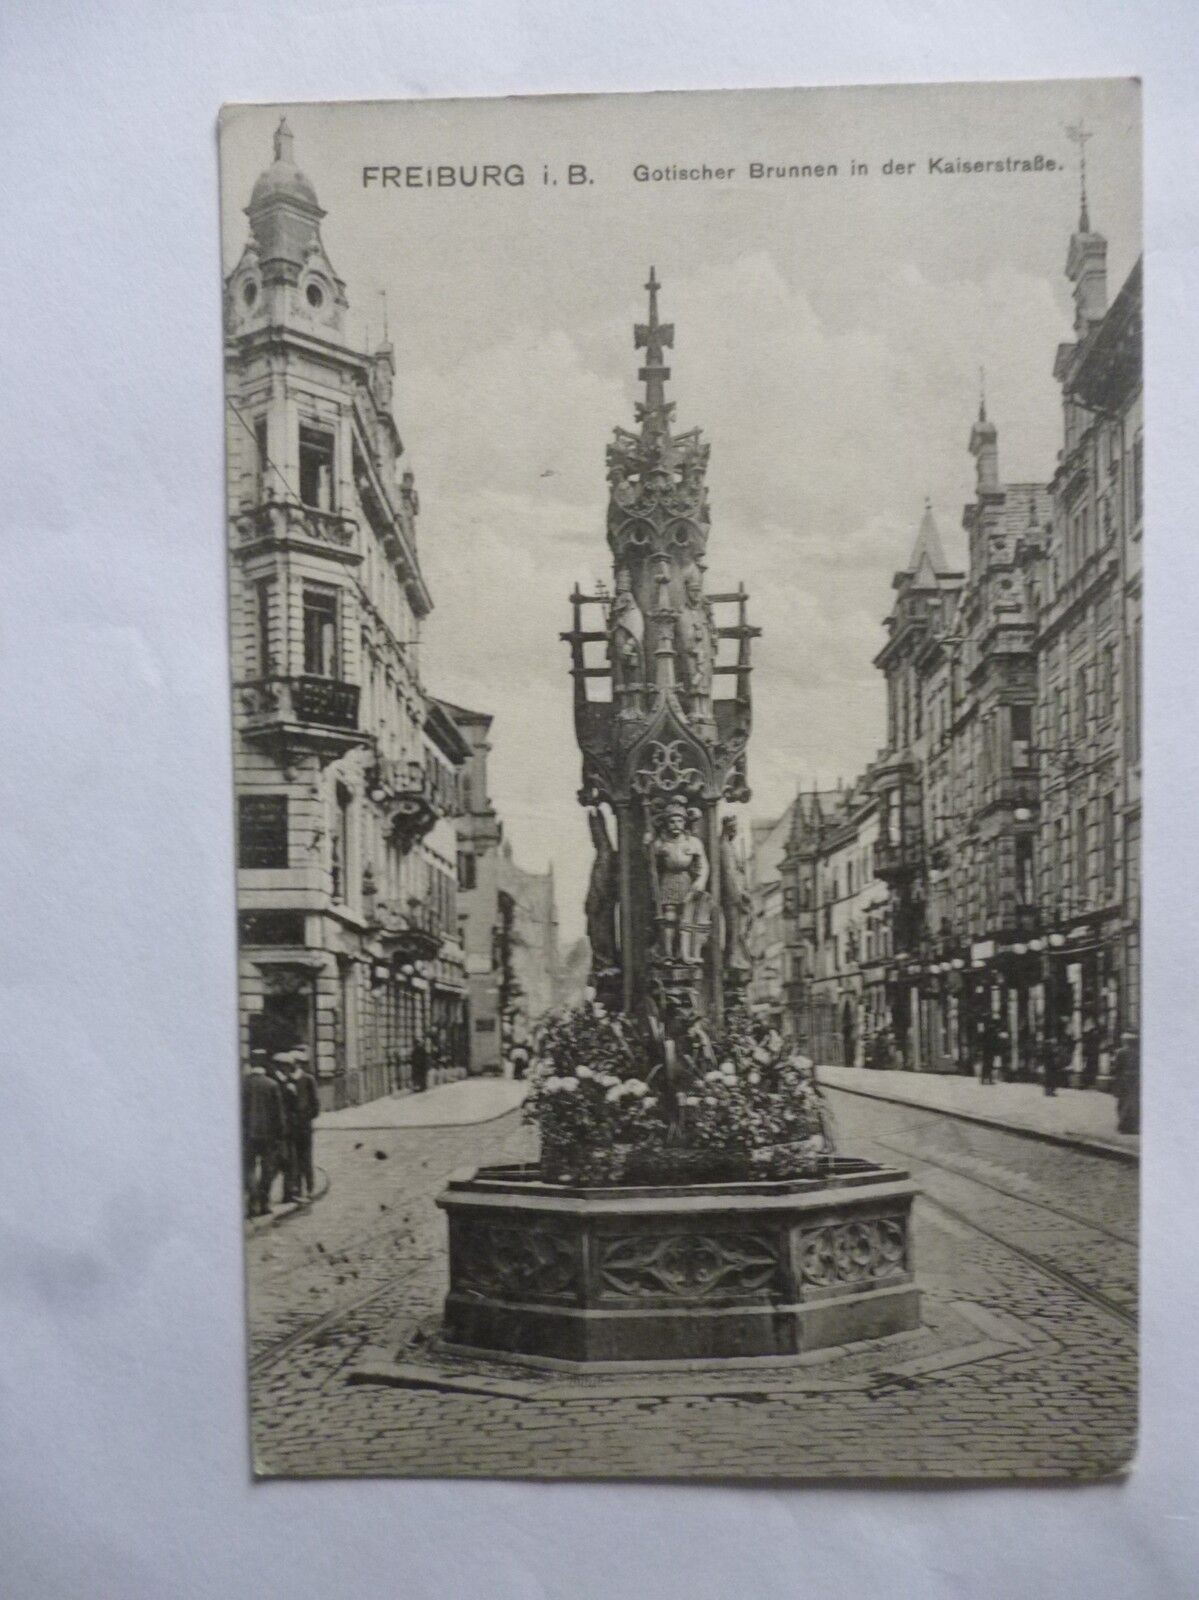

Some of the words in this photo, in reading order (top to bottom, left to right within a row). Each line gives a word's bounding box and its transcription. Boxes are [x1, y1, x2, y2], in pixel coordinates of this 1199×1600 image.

[362, 164, 525, 189] FREIBURG
[542, 164, 559, 187] i.
[567, 163, 596, 187] B.
[632, 162, 736, 183] Gotischer
[748, 162, 840, 180] Brunnen
[850, 159, 870, 178] in
[881, 157, 918, 177] der
[928, 153, 1065, 176] Kaiserstraße.
